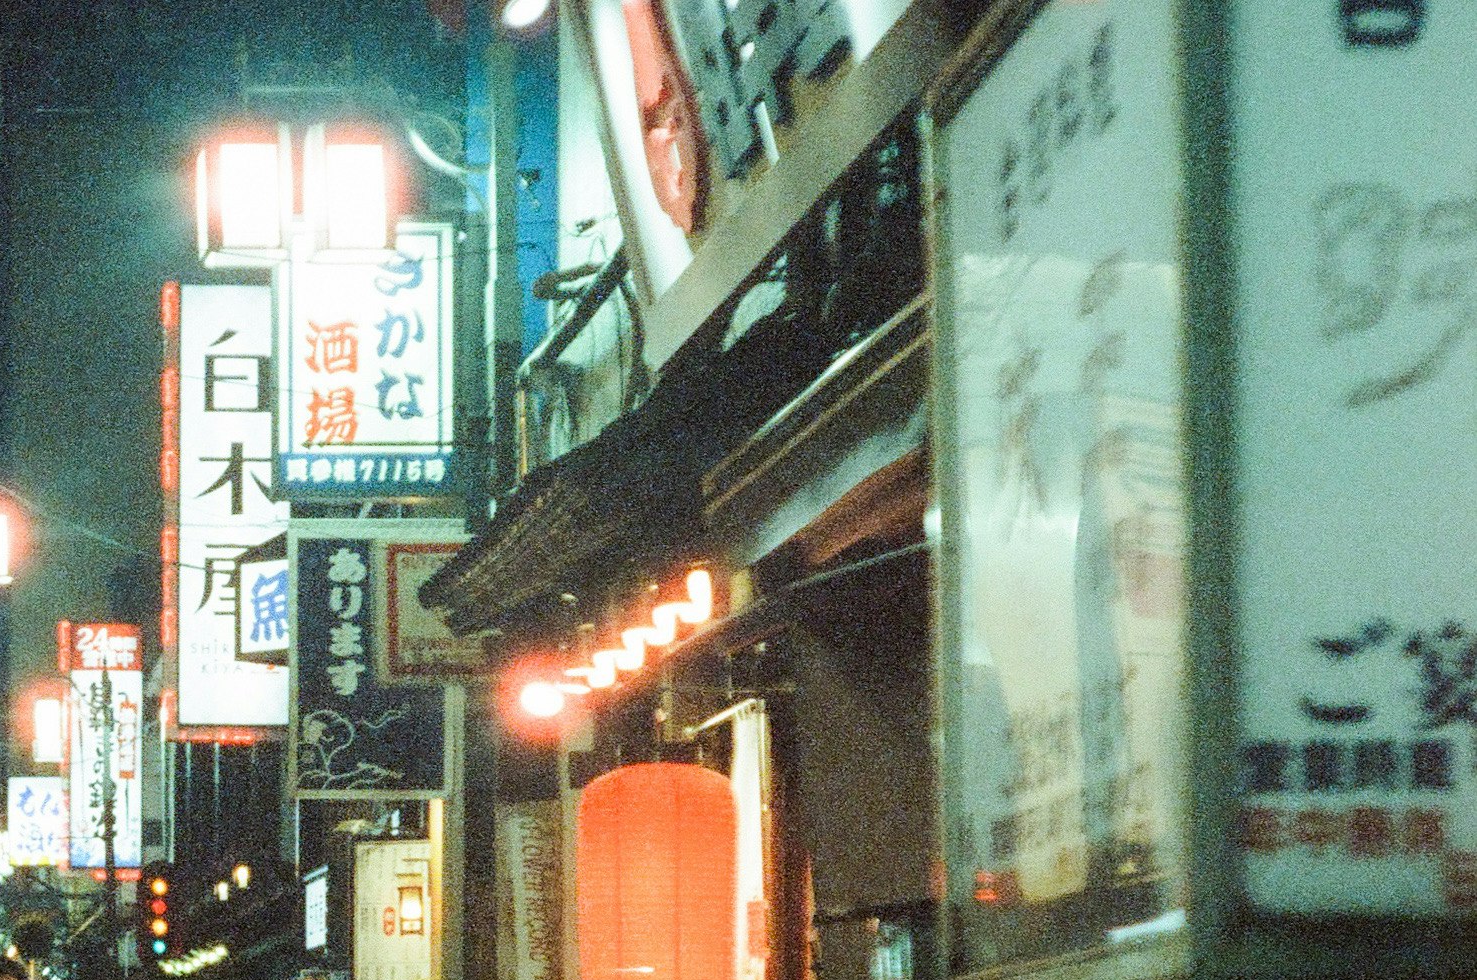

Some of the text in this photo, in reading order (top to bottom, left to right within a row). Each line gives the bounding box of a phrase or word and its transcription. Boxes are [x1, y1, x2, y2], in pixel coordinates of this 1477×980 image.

[304, 318, 360, 444] 酒場
[374, 251, 425, 420] さかな
[194, 329, 275, 617] 白木屋
[249, 568, 289, 643] 魚
[326, 545, 372, 698] あります
